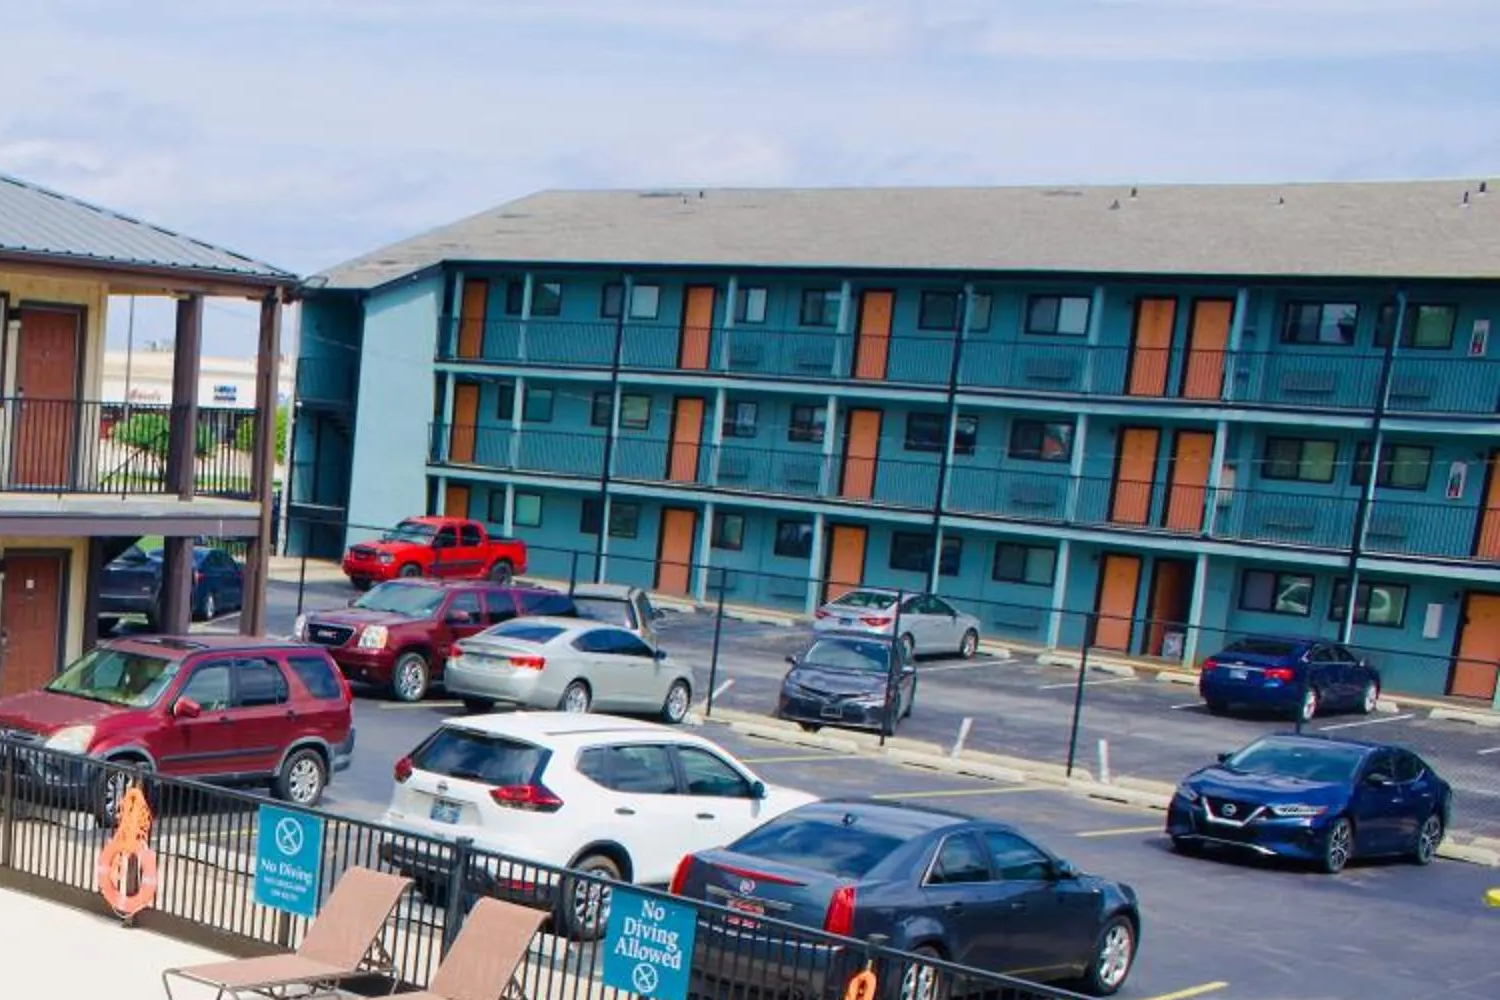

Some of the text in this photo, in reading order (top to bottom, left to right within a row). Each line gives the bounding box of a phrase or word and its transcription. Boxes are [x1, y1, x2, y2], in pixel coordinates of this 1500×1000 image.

[261, 858, 277, 873] No
[279, 862, 312, 885] Diving
[641, 900, 665, 920] No
[624, 917, 679, 952] Diving
[614, 937, 682, 970] Allowed
